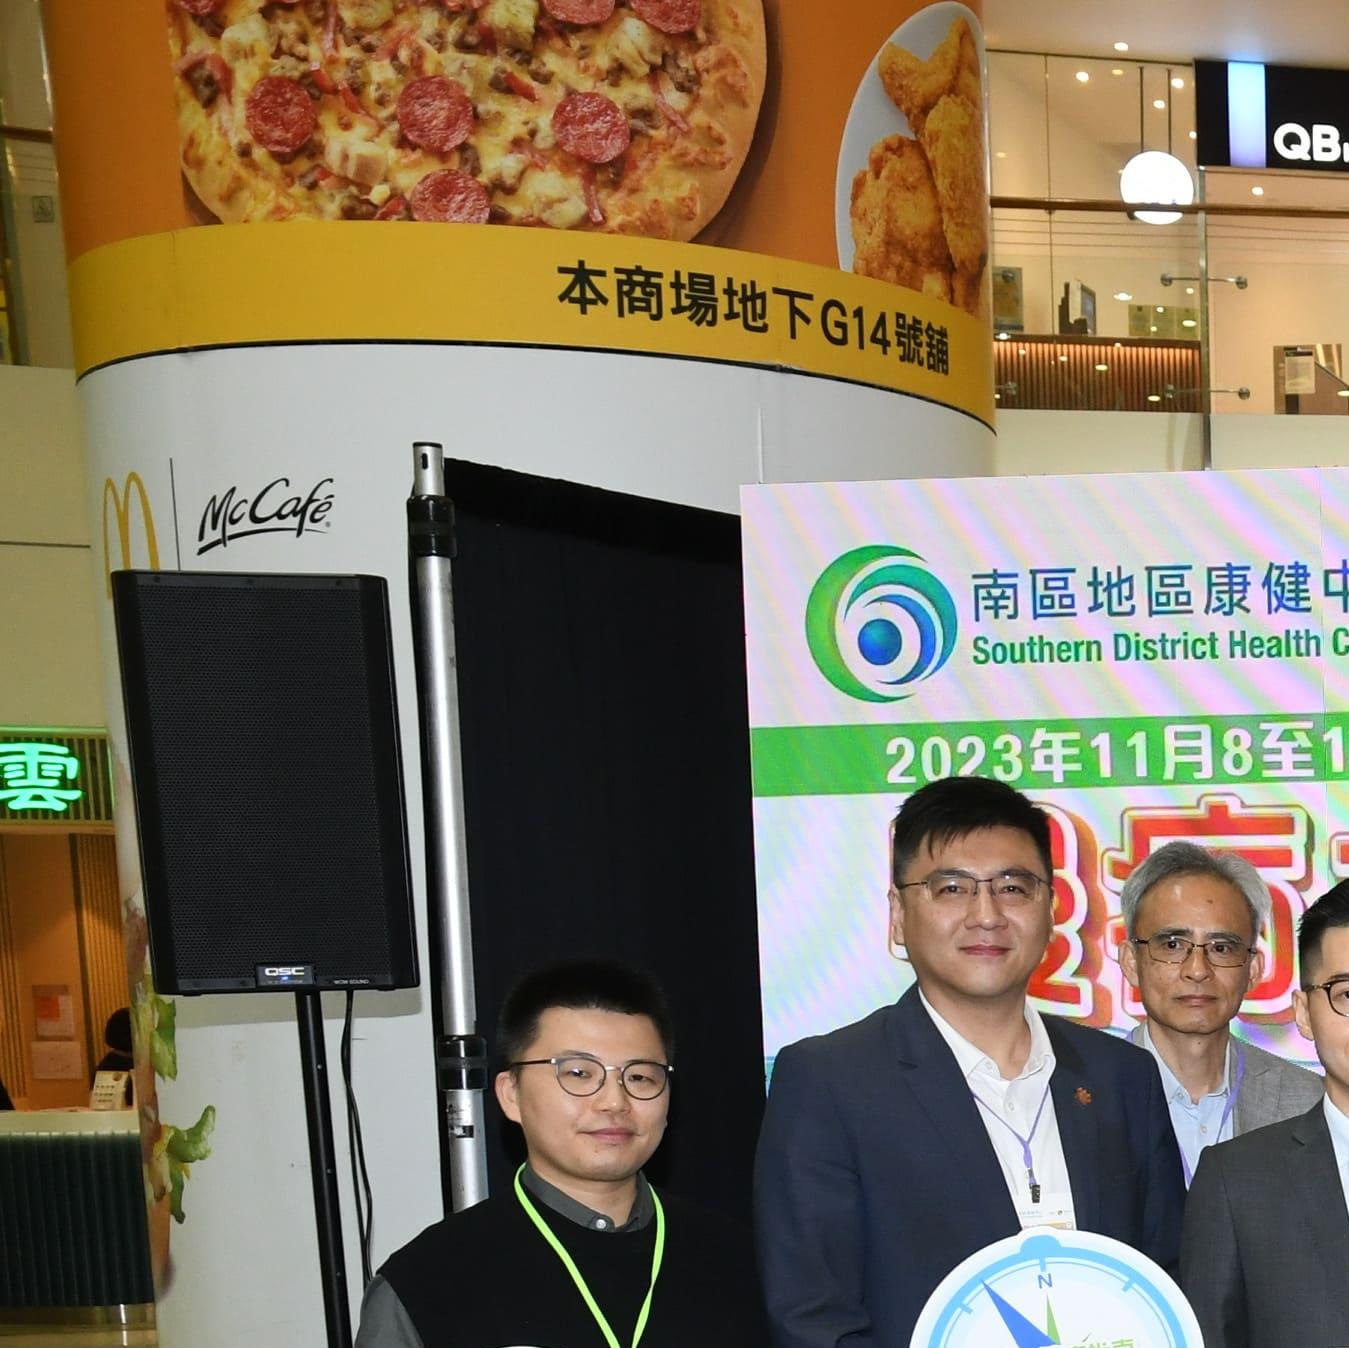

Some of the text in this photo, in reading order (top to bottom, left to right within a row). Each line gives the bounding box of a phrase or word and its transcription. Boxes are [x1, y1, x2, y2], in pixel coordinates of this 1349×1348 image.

[556, 260, 950, 376] 本商場地下G14號舖
[197, 478, 335, 556] McCafé
[972, 632, 1102, 666] Southern
[1113, 629, 1220, 661] District
[1228, 628, 1322, 659] Health
[264, 967, 305, 977] QSC
[1038, 1273, 1053, 1289] N
